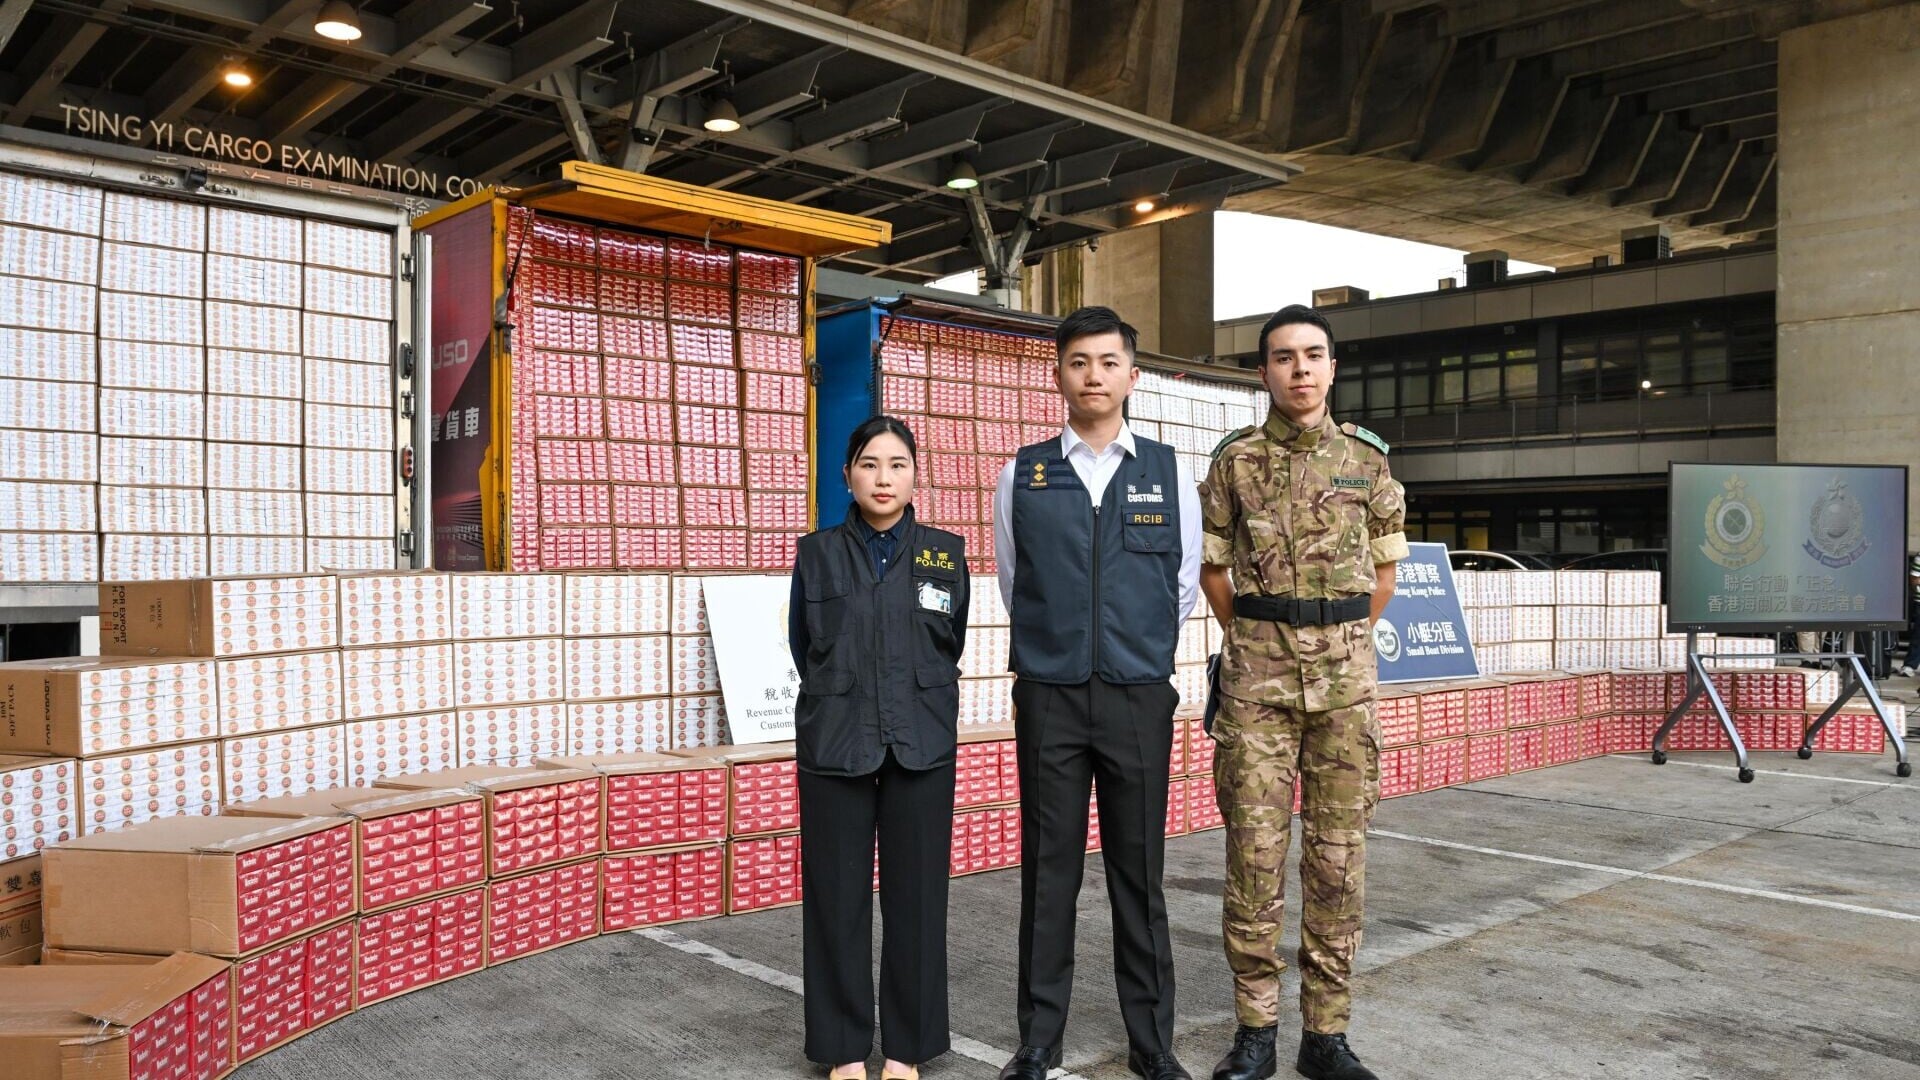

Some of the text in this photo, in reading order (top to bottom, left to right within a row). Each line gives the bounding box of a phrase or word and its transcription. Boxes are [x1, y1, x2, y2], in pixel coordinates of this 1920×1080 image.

[59, 104, 141, 141] TSING
[150, 120, 173, 148] YI
[184, 128, 272, 164] CARGO
[281, 144, 437, 194] EXAMINATION
[1127, 493, 1164, 503] CUSTOMS
[1134, 514, 1163, 524] RCIB
[915, 556, 955, 570] POLICE
[1410, 586, 1429, 598] Kong
[1427, 586, 1447, 596] Police
[119, 607, 127, 644] EXPORT
[1405, 644, 1465, 656] Small Boat Division
[746, 708, 783, 719] Revenue
